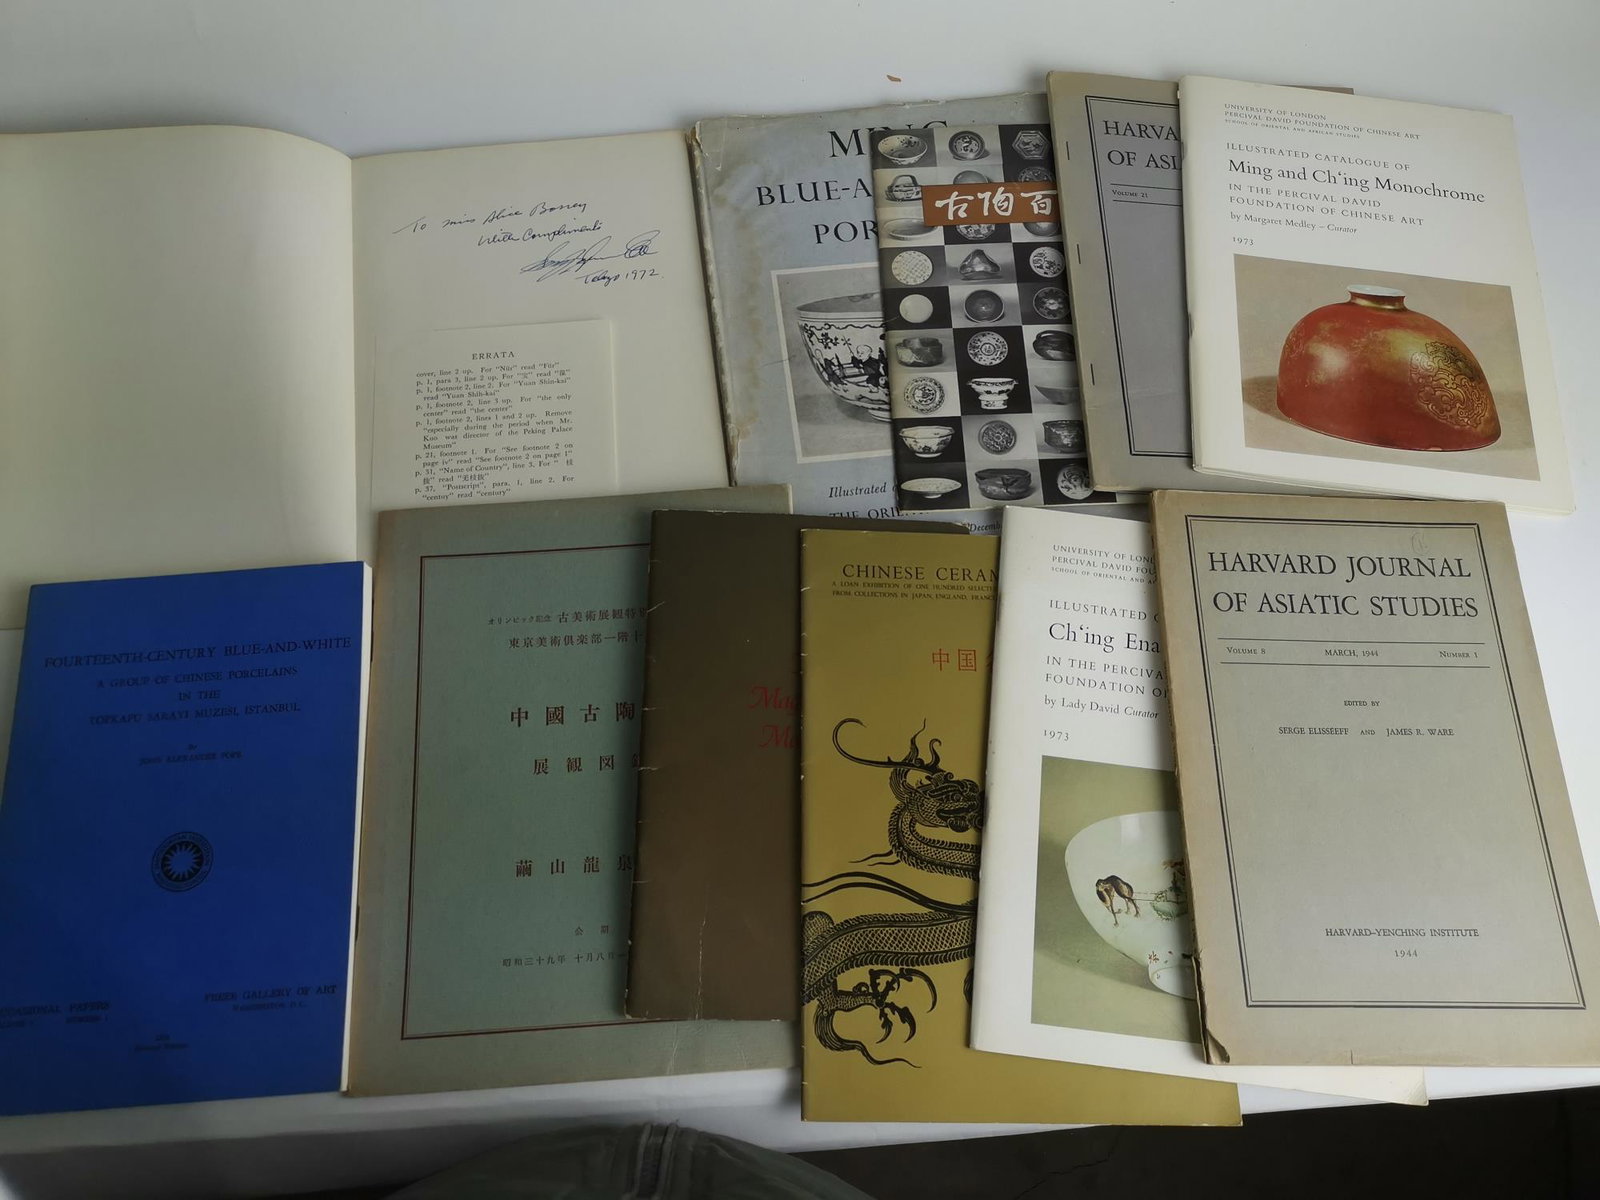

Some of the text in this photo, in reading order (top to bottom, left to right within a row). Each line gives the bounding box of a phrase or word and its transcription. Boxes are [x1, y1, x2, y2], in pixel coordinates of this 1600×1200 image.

[1224, 103, 1273, 114] UNIVERSITY
[1290, 111, 1326, 120] LONDON
[1103, 120, 1181, 142] HARVA
[1224, 111, 1263, 121] PERCIVAL
[1266, 116, 1292, 125] DAVID
[1295, 119, 1350, 131] FOUNDATION
[1367, 127, 1401, 137] CHINESE
[1107, 149, 1137, 167] OF
[1227, 142, 1410, 171] ILLUSTRATED CATALOGUE OF
[1228, 159, 1272, 180] Ming
[1278, 165, 1307, 181] and
[1375, 177, 1485, 202] Monochrome
[755, 178, 872, 206] BLUE-A
[1229, 183, 1382, 208] IN THE PERCIVAL DAVID
[483, 206, 523, 225] Alice
[1230, 196, 1424, 226] FOUNDATION OF CHINESE ART
[1230, 212, 1241, 224] by
[1244, 213, 1282, 228] Margaret
[1285, 218, 1316, 232] Medley
[1327, 223, 1357, 235] Curator
[1232, 236, 1255, 246] 1973
[472, 351, 515, 361] ERRATA
[829, 482, 887, 498] Illustrated
[1053, 545, 1109, 558] UNIVERSITY
[1114, 552, 1127, 560] OF
[842, 564, 925, 580] CHINESE
[1052, 556, 1098, 568] PERCIVAL
[1102, 562, 1132, 572] DAVID
[1207, 551, 1472, 583] HARVARD JOURNAL
[1052, 567, 1078, 575] SCHOOL
[1093, 572, 1126, 581] ORIENTAL
[1050, 599, 1147, 620] ILLUSTRATED
[1212, 592, 1479, 618] OF ASIATIC STUDIES
[44, 637, 352, 669] FOURTEENTH-CENTURY BLUE-AND-WHITE
[1261, 647, 1266, 655] 8
[1324, 648, 1379, 658] MARCH, 1944
[1046, 655, 1061, 665] IN
[1068, 658, 1097, 670] THE
[110, 676, 150, 689] GROUP
[154, 675, 170, 684] OF
[174, 671, 222, 684] CHINESE
[228, 665, 298, 681] PORCELAINS
[1045, 673, 1145, 695] FOUNDATION
[178, 689, 221, 701] IN THE
[1044, 694, 1159, 719] by Lady David Curator
[1043, 729, 1069, 742] 1973
[1278, 726, 1306, 736] SERGE
[1308, 727, 1349, 736] ELISSEEFF
[1385, 727, 1413, 737] JAMES
[1427, 728, 1455, 737] WARE
[1430, 928, 1479, 937] INSTITUTE
[1394, 949, 1418, 958] 1944
